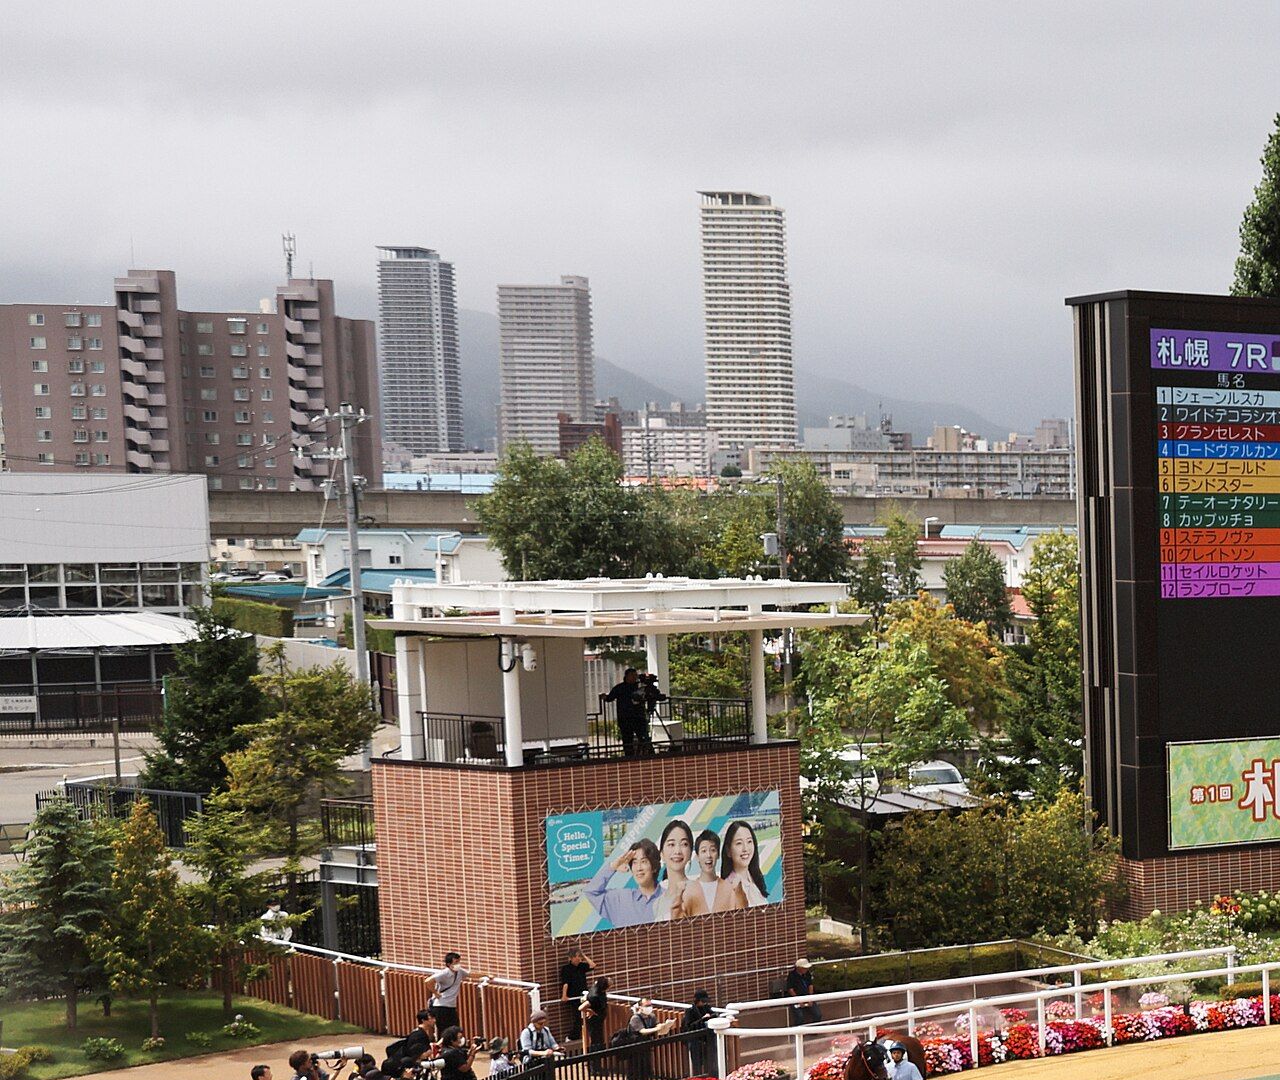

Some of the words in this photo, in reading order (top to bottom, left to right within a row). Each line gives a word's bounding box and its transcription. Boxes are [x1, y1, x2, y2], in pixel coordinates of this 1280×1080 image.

[1157, 337, 1210, 367] 札幌
[1227, 342, 1267, 369] 7R
[1217, 373, 1245, 388] 馬名
[1161, 390, 1166, 403] 1
[1174, 391, 1264, 406] シェーンルスカ
[1161, 407, 1167, 421] 2
[1162, 425, 1168, 439] 3
[1176, 425, 1265, 441] グランセレスト
[1162, 443, 1168, 456] 4
[1162, 461, 1169, 475] 5
[1179, 460, 1266, 475] ヨドノゴールド
[1162, 479, 1169, 492] 6
[1177, 478, 1253, 493] ランドスター
[1163, 496, 1169, 509] 7
[1178, 495, 1278, 510] テーオーナタリー
[1163, 513, 1170, 527] 8
[1164, 530, 1170, 545] 9
[1162, 548, 1174, 562] 10
[1179, 547, 1259, 562] グレイトソン
[1162, 566, 1174, 579] 11
[1180, 565, 1271, 580] セイルロケット
[1162, 584, 1174, 597] 12
[564, 832, 587, 840] Hello,
[561, 841, 590, 853] Special
